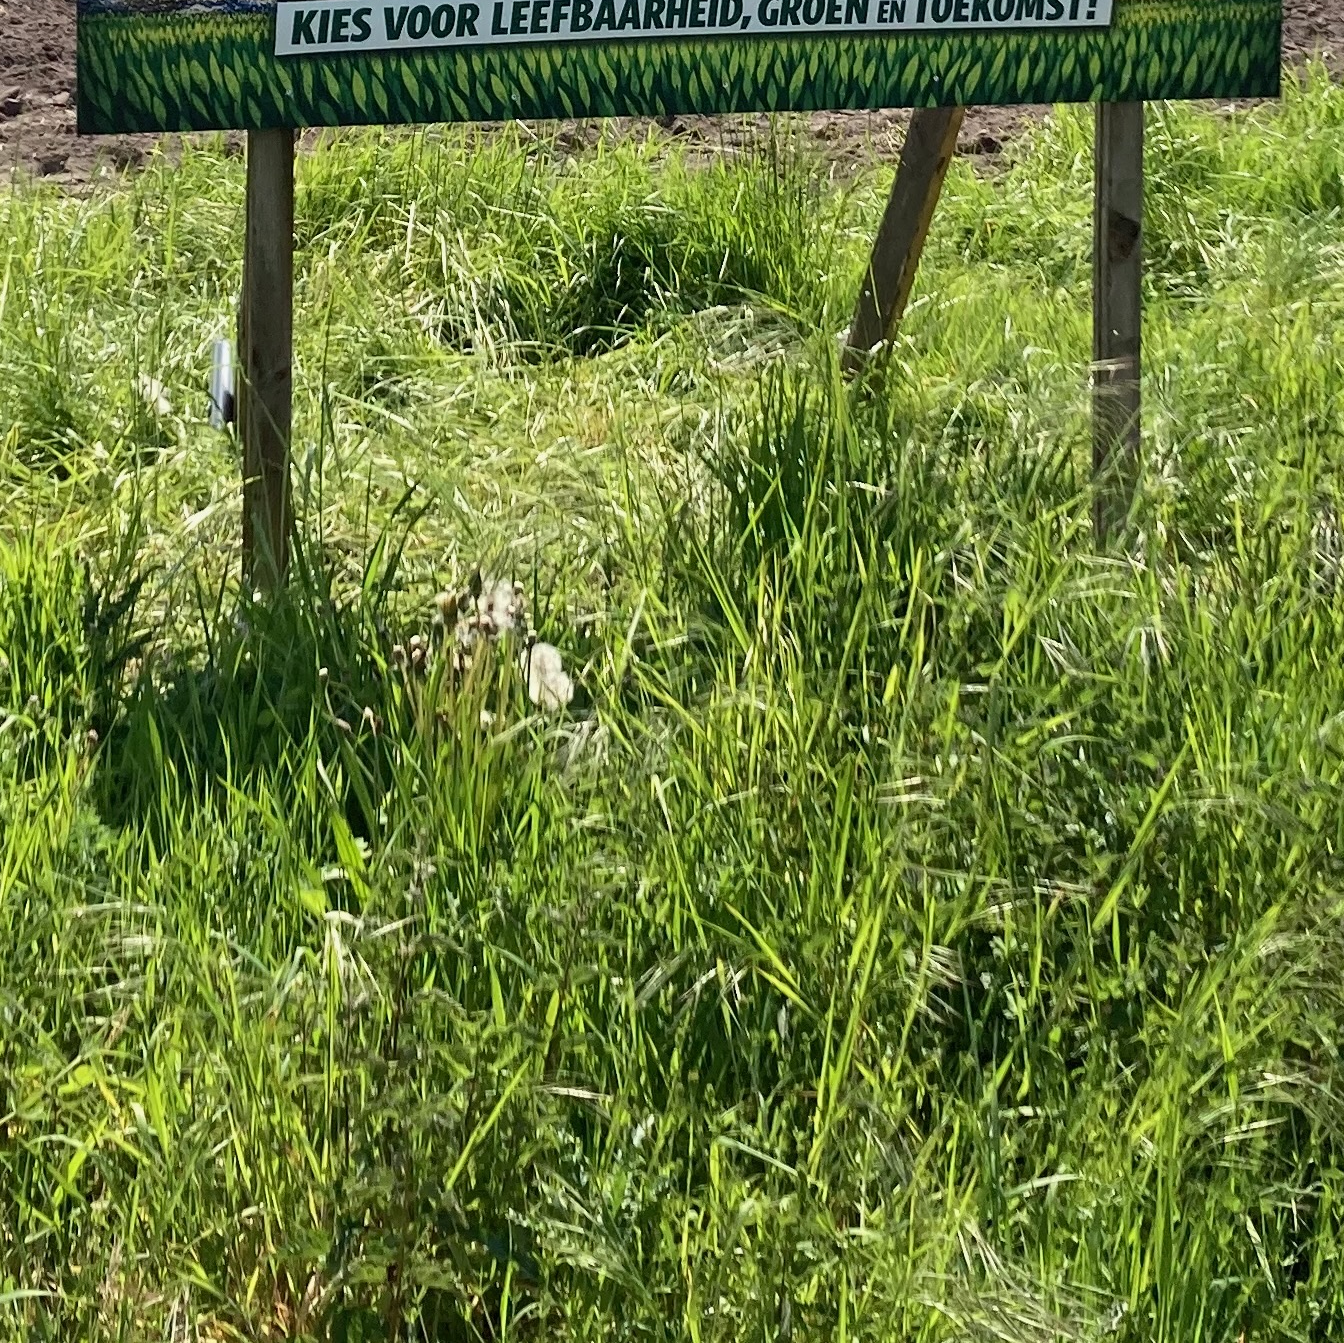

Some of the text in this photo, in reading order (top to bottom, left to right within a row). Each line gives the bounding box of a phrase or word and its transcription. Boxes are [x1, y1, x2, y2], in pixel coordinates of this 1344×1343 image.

[290, 5, 373, 46] KIES
[383, 1, 480, 40] VOOR
[877, 0, 906, 24] EN
